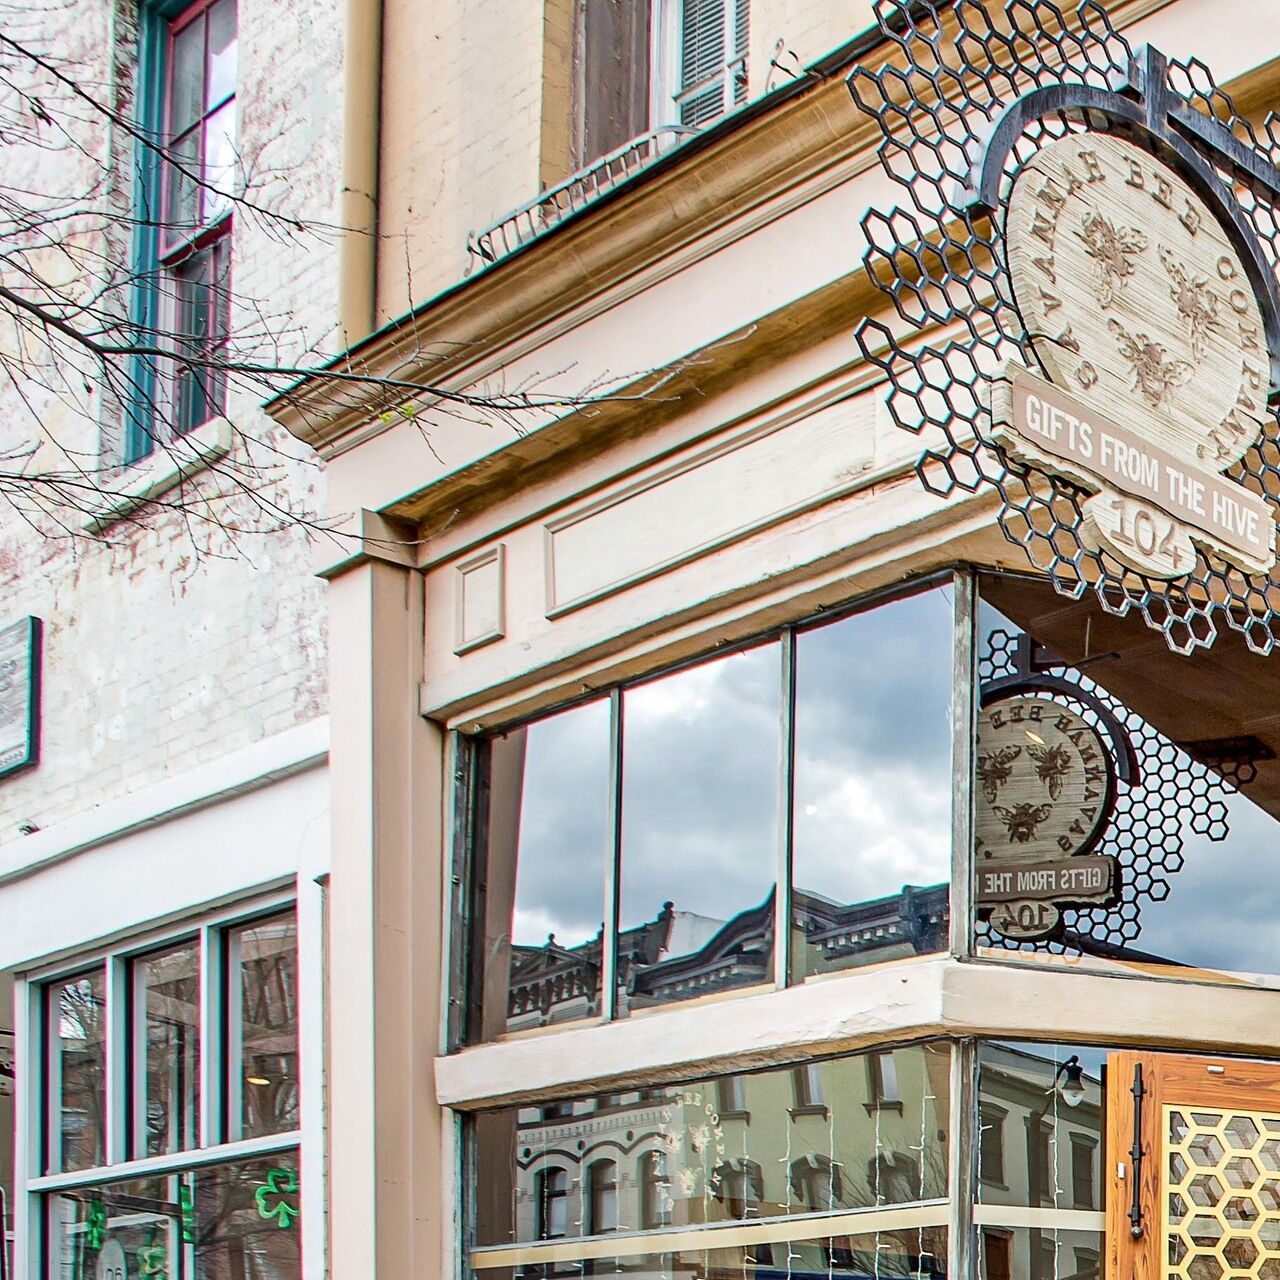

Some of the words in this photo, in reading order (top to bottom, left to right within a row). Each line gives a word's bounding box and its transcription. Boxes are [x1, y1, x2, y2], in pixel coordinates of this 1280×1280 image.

[1029, 149, 1106, 391] SAVANNAH
[1123, 154, 1201, 237] BEE
[1208, 255, 1262, 459] COMPANY
[1025, 394, 1093, 458] GIFTS
[1100, 431, 1160, 493] FROM
[1165, 464, 1206, 518] THE
[1212, 490, 1260, 545] HIVE
[1110, 499, 1184, 570] 104
